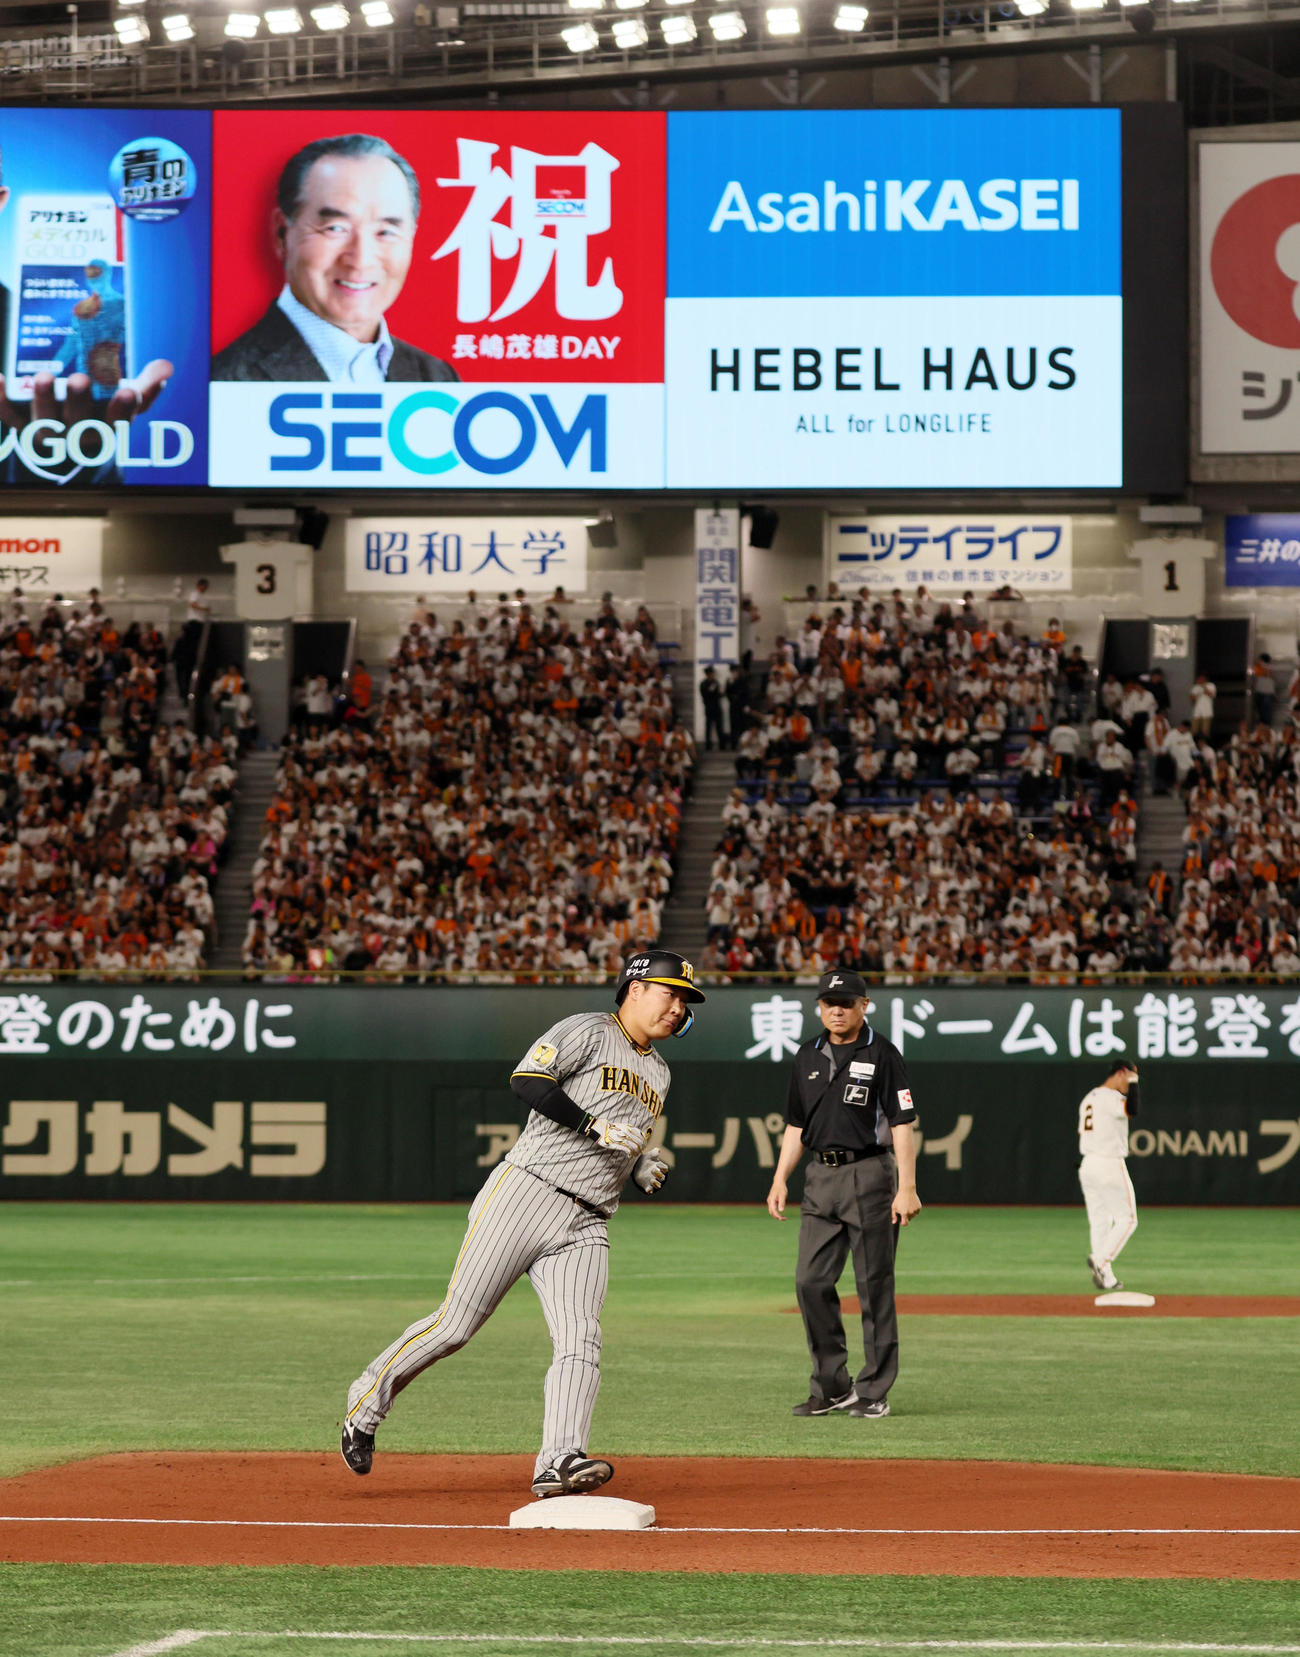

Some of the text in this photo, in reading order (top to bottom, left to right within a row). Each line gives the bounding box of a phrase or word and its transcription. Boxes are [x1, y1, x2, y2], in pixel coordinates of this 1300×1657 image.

[122, 148, 187, 188] 青の
[29, 209, 88, 223] アリナミン
[708, 178, 1080, 233] AsahiKASEI
[431, 137, 624, 323] 祝
[711, 347, 1077, 392] HEBEL HAUS
[20, 418, 195, 468] GOLD
[268, 390, 608, 475] SECOM
[796, 413, 993, 433] ALL for LONGLIFE
[365, 529, 567, 576] 昭和大学
[838, 525, 1062, 561] ニッテイライフ
[257, 564, 275, 594] 3
[1164, 561, 1179, 591] 1
[698, 548, 737, 664] 関電工
[0, 993, 297, 1053] 登のために
[745, 993, 1300, 1061] 東ドームは能登
[3, 1101, 327, 1176] クカメラ
[1084, 1104, 1094, 1131] 2
[1128, 1129, 1248, 1157] ONAMI
